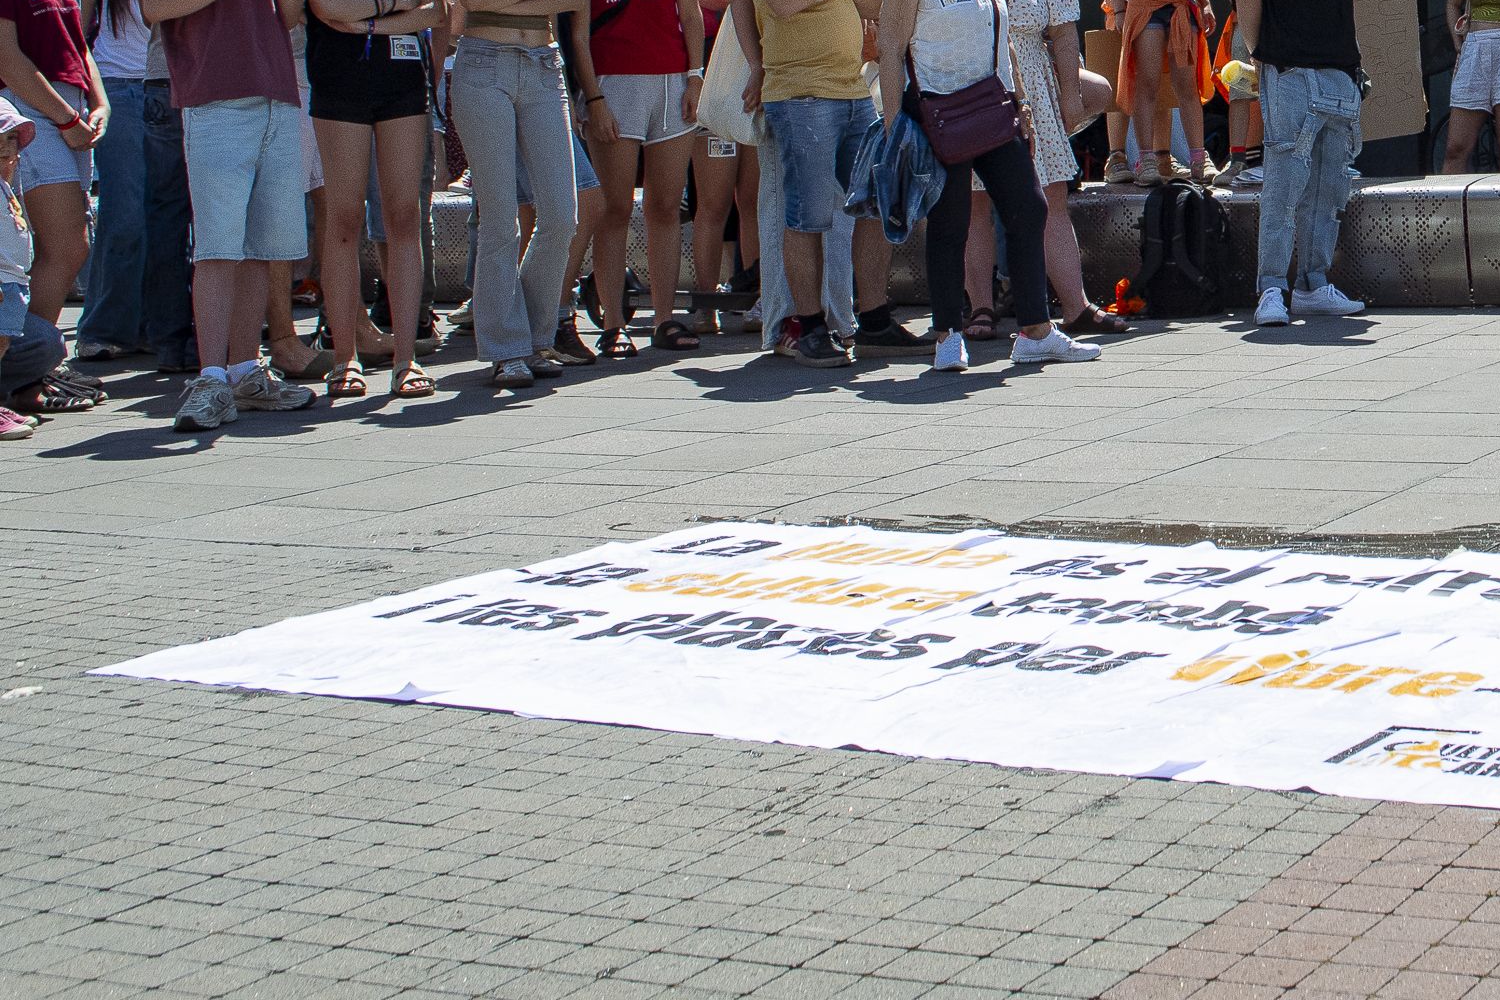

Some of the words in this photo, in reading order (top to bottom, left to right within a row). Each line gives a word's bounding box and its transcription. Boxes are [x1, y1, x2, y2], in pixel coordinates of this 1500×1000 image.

[651, 535, 783, 558] La
[1143, 566, 1276, 588] al
[423, 598, 610, 631] les
[930, 640, 1173, 675] per
